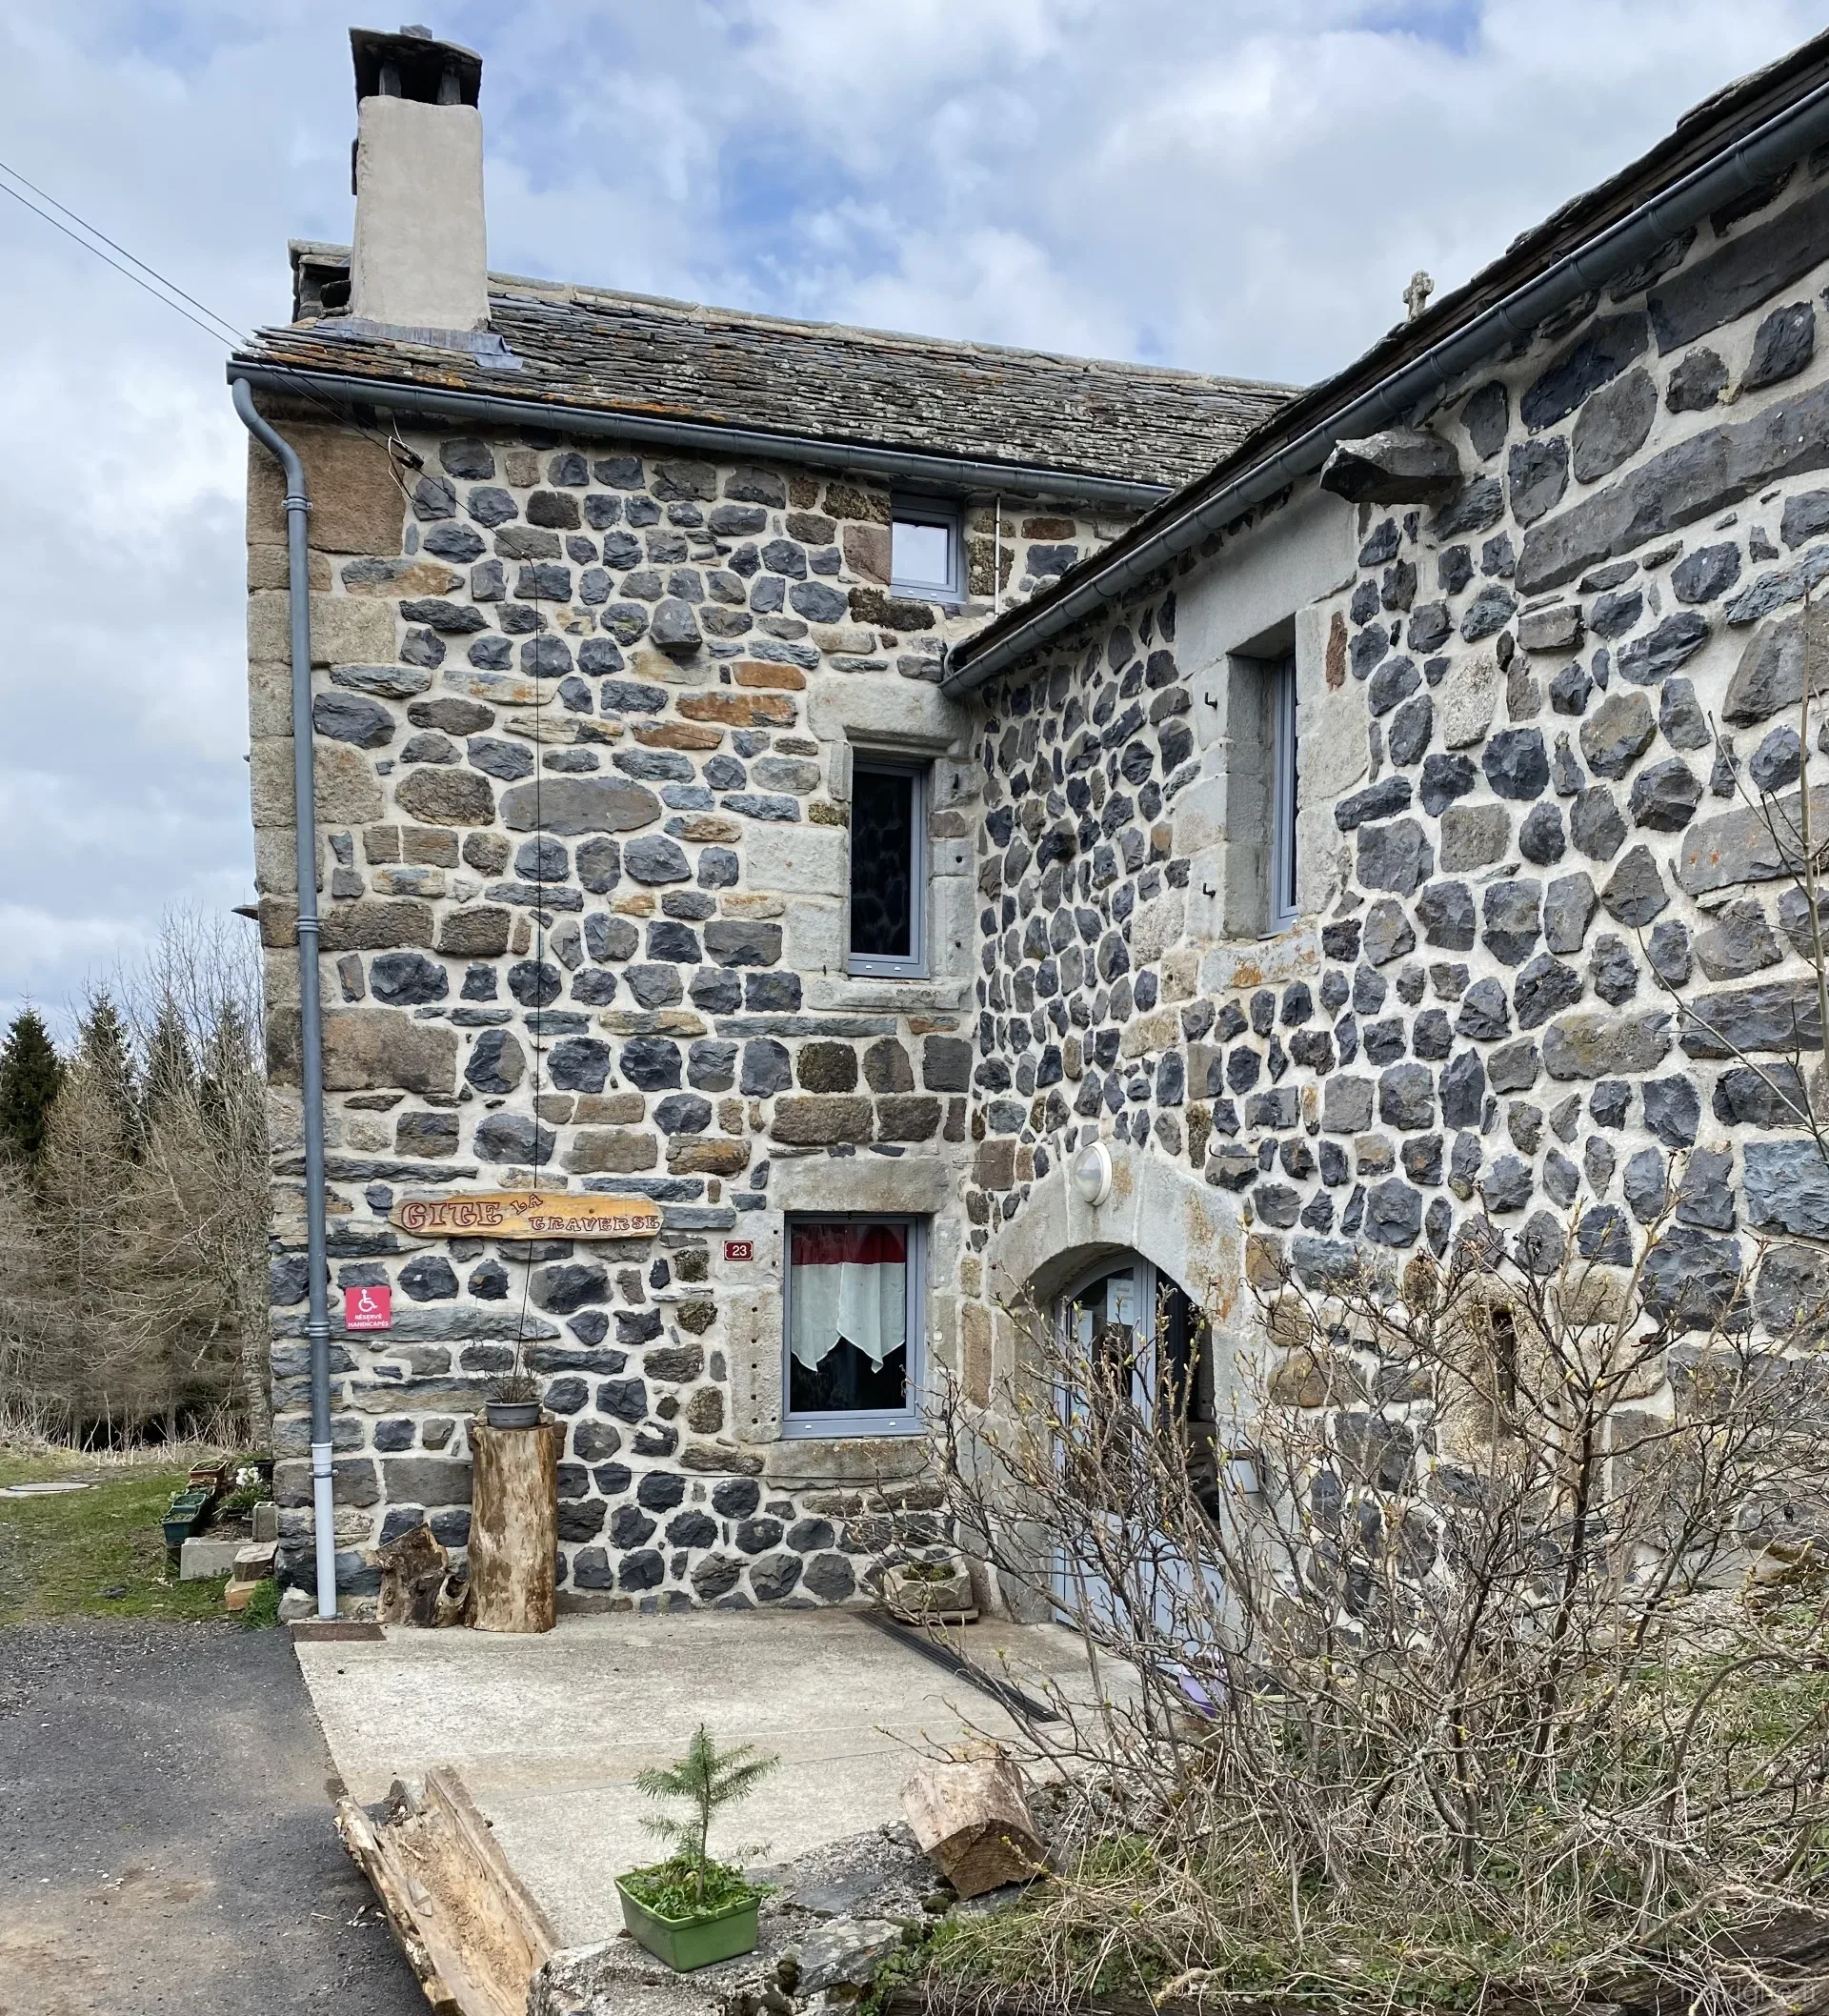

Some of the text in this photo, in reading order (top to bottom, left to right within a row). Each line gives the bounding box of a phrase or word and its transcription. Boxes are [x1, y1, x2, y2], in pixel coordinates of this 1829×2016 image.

[510, 1194, 544, 1215] LA
[401, 1201, 504, 1230] GITE
[529, 1215, 661, 1232] TRAVERSE
[732, 1244, 748, 1257] 23
